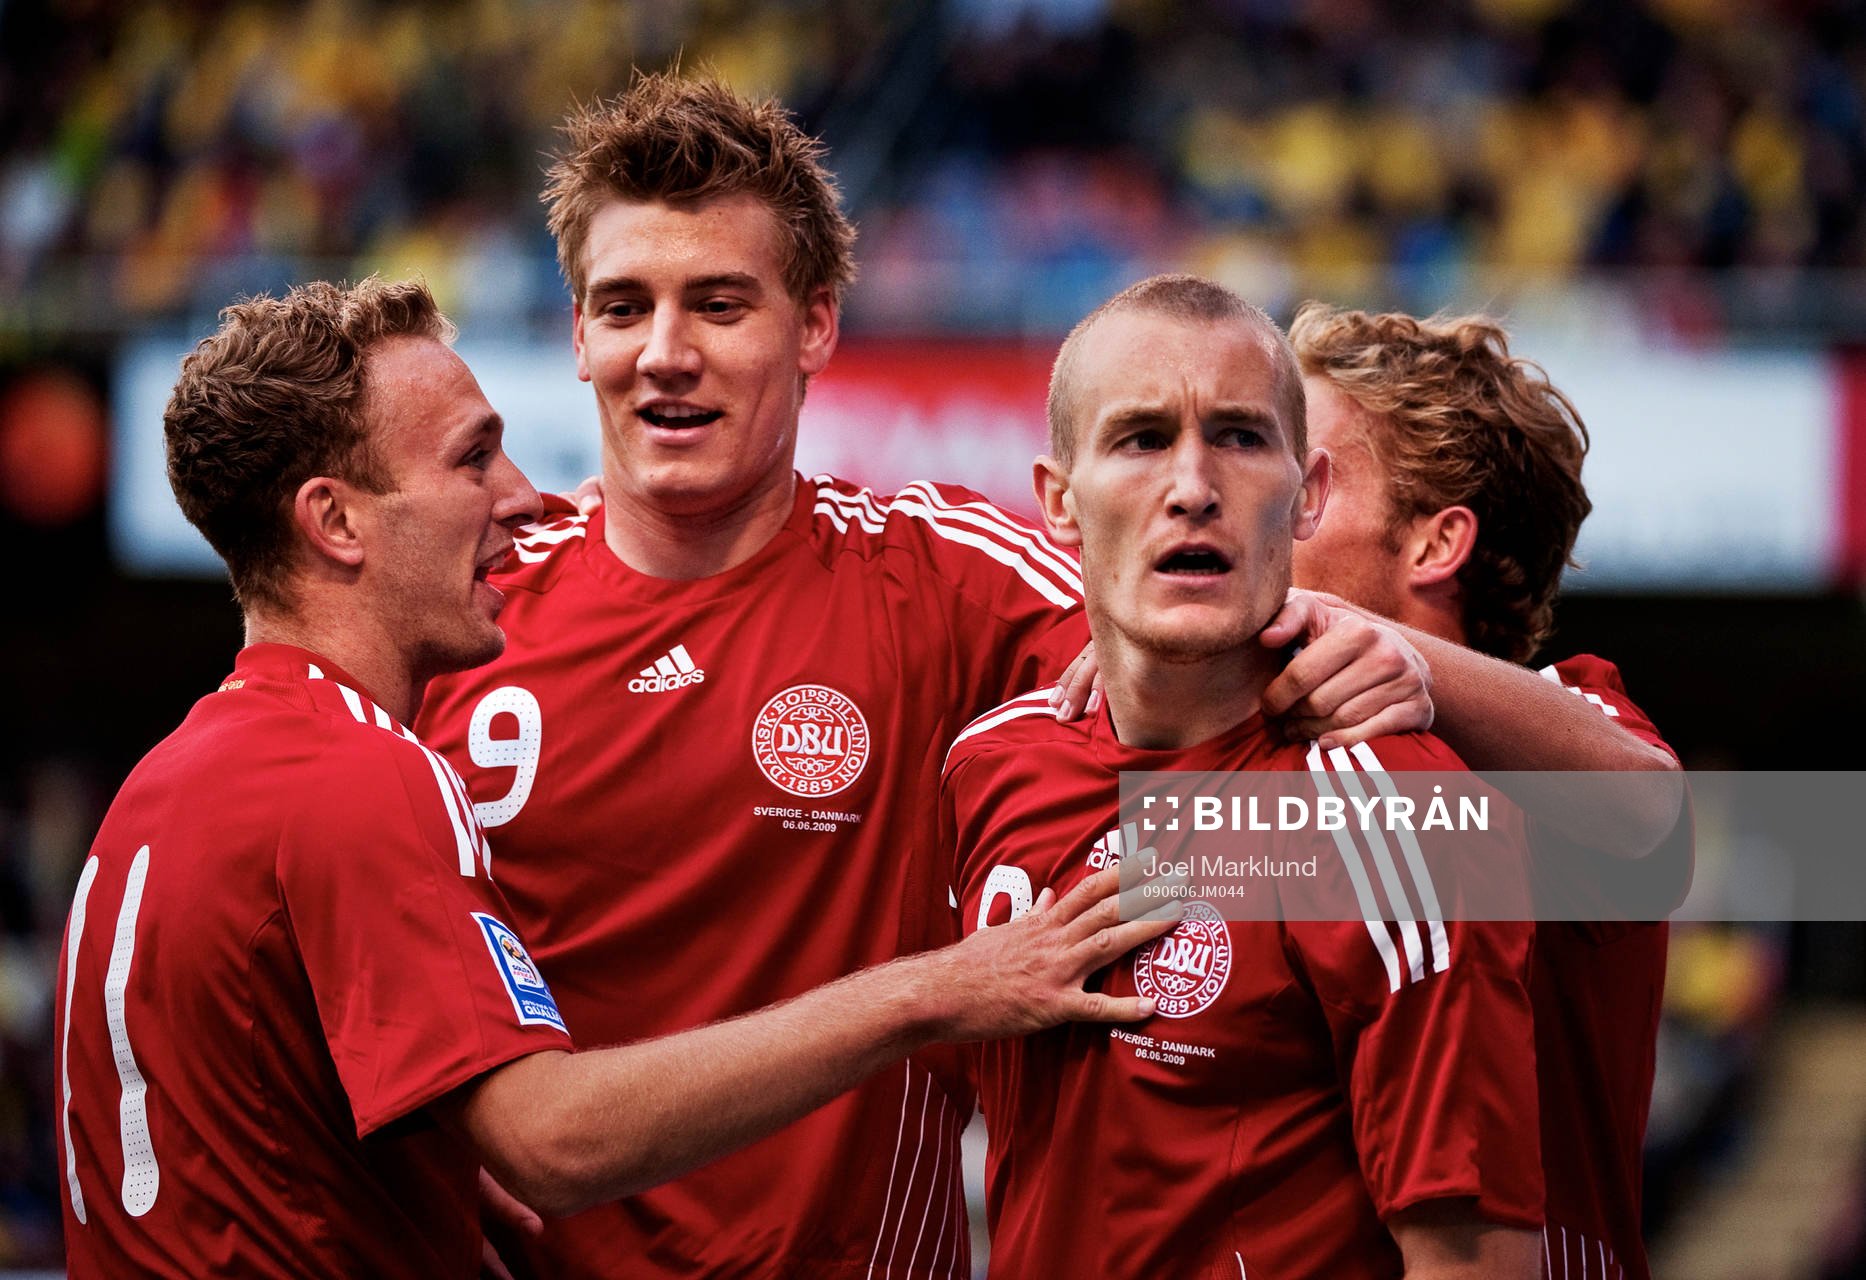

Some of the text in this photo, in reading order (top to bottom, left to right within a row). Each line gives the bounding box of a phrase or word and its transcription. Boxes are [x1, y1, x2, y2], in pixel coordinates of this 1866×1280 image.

[628, 667, 705, 693] adidas
[757, 712, 786, 780] DANSK
[777, 722, 845, 757] DBU
[468, 686, 542, 828] 9
[786, 776, 833, 793] 1889
[754, 806, 802, 818] SVERIGE
[811, 810, 862, 823] DANMARK
[782, 820, 837, 832] 06.06.2009
[1153, 937, 1212, 977] DBU
[1110, 1028, 1155, 1048] SVERIGE
[1161, 1040, 1216, 1058] DANMARK
[1135, 1047, 1186, 1065] 06.06.2009
